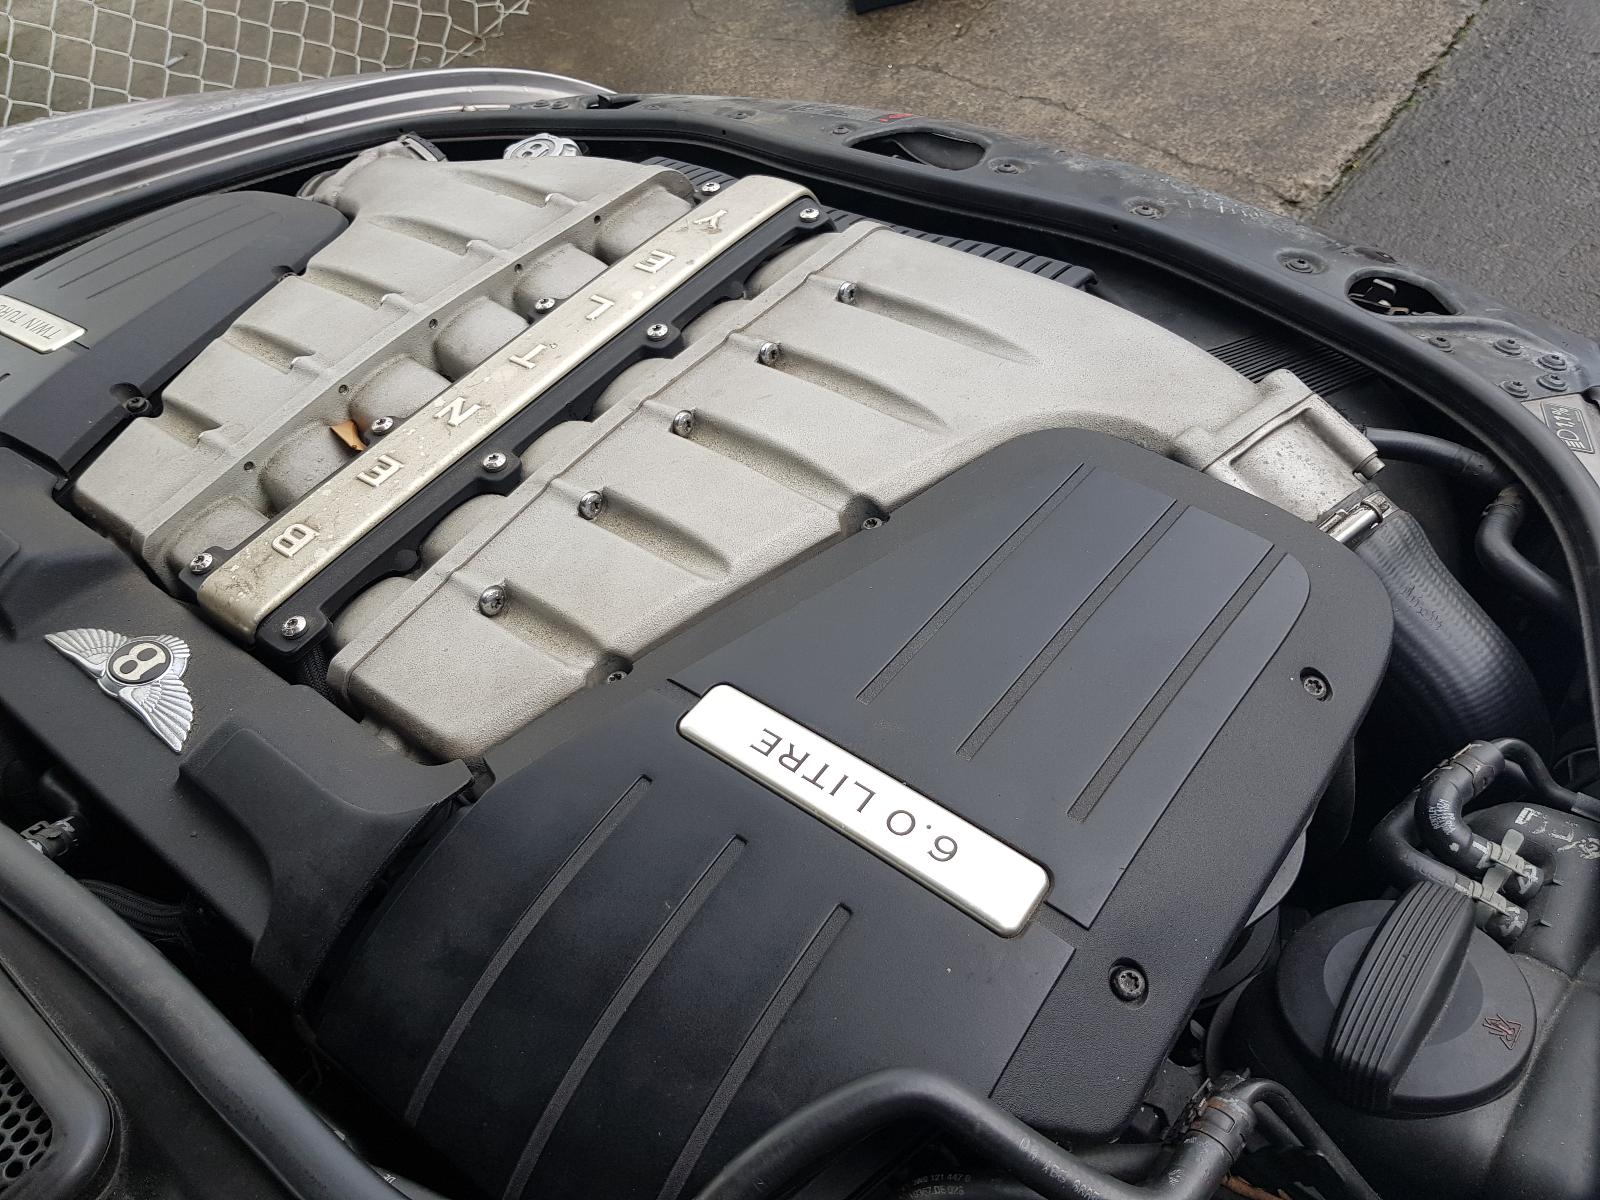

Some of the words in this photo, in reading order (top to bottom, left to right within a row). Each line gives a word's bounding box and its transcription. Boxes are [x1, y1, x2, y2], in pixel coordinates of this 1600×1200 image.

[21, 317, 62, 340] TWIN
[271, 208, 729, 558] BENTLEY
[113, 642, 166, 681] B
[750, 728, 877, 814] LITRE
[886, 809, 958, 862] 6.0
